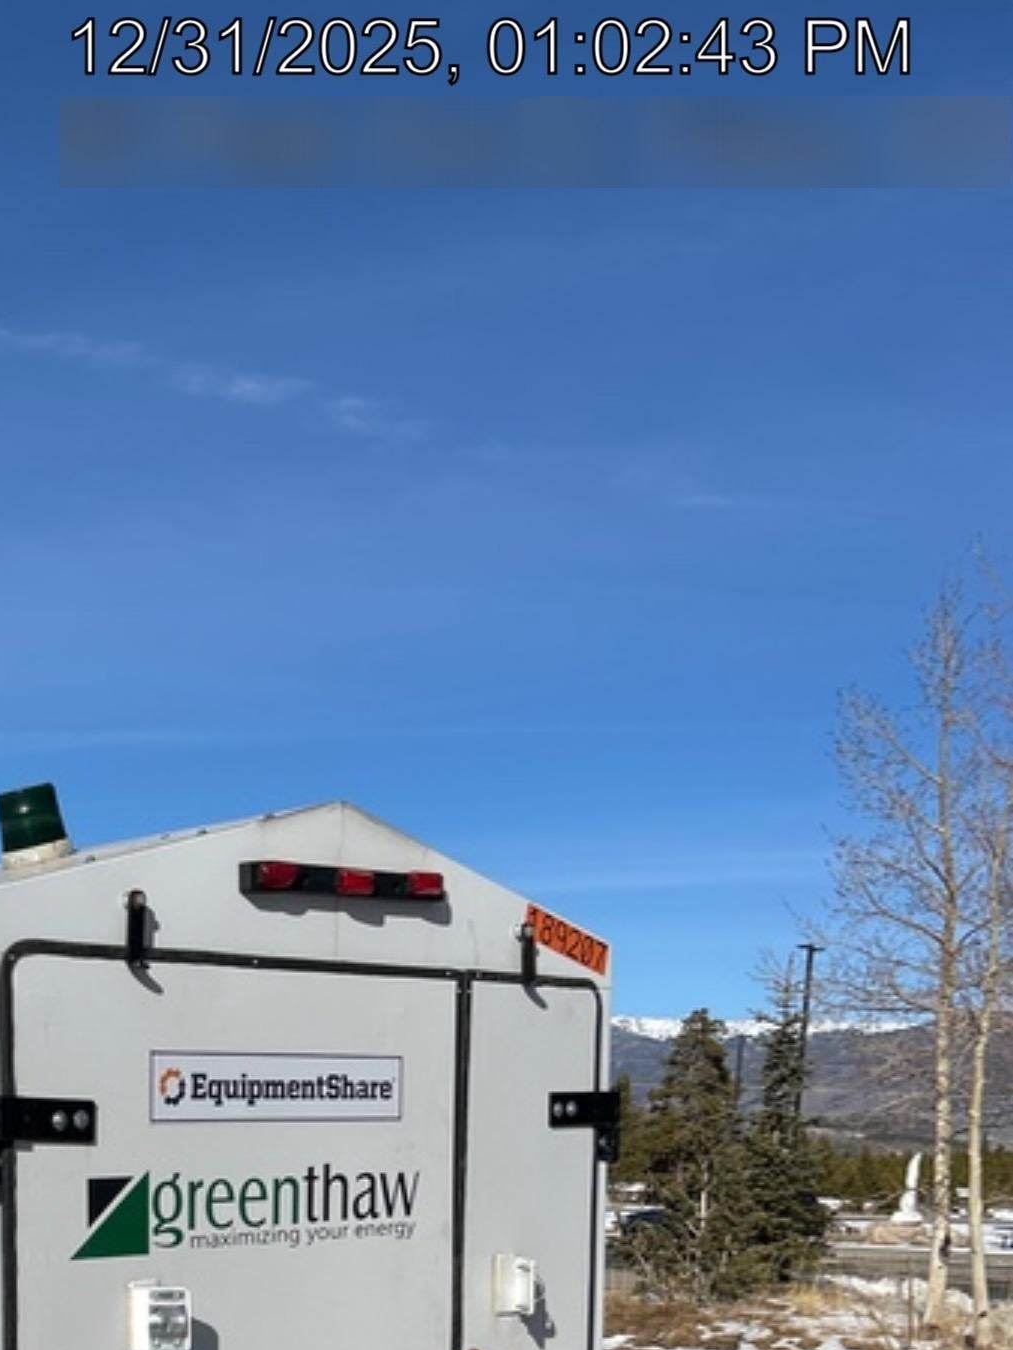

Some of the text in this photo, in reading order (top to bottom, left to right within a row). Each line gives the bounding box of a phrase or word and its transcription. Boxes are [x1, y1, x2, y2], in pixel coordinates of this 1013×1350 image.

[191, 1073, 393, 1106] EquipmentShare
[152, 1163, 420, 1248] greenthaw
[190, 1219, 417, 1248] maximizing your energy
